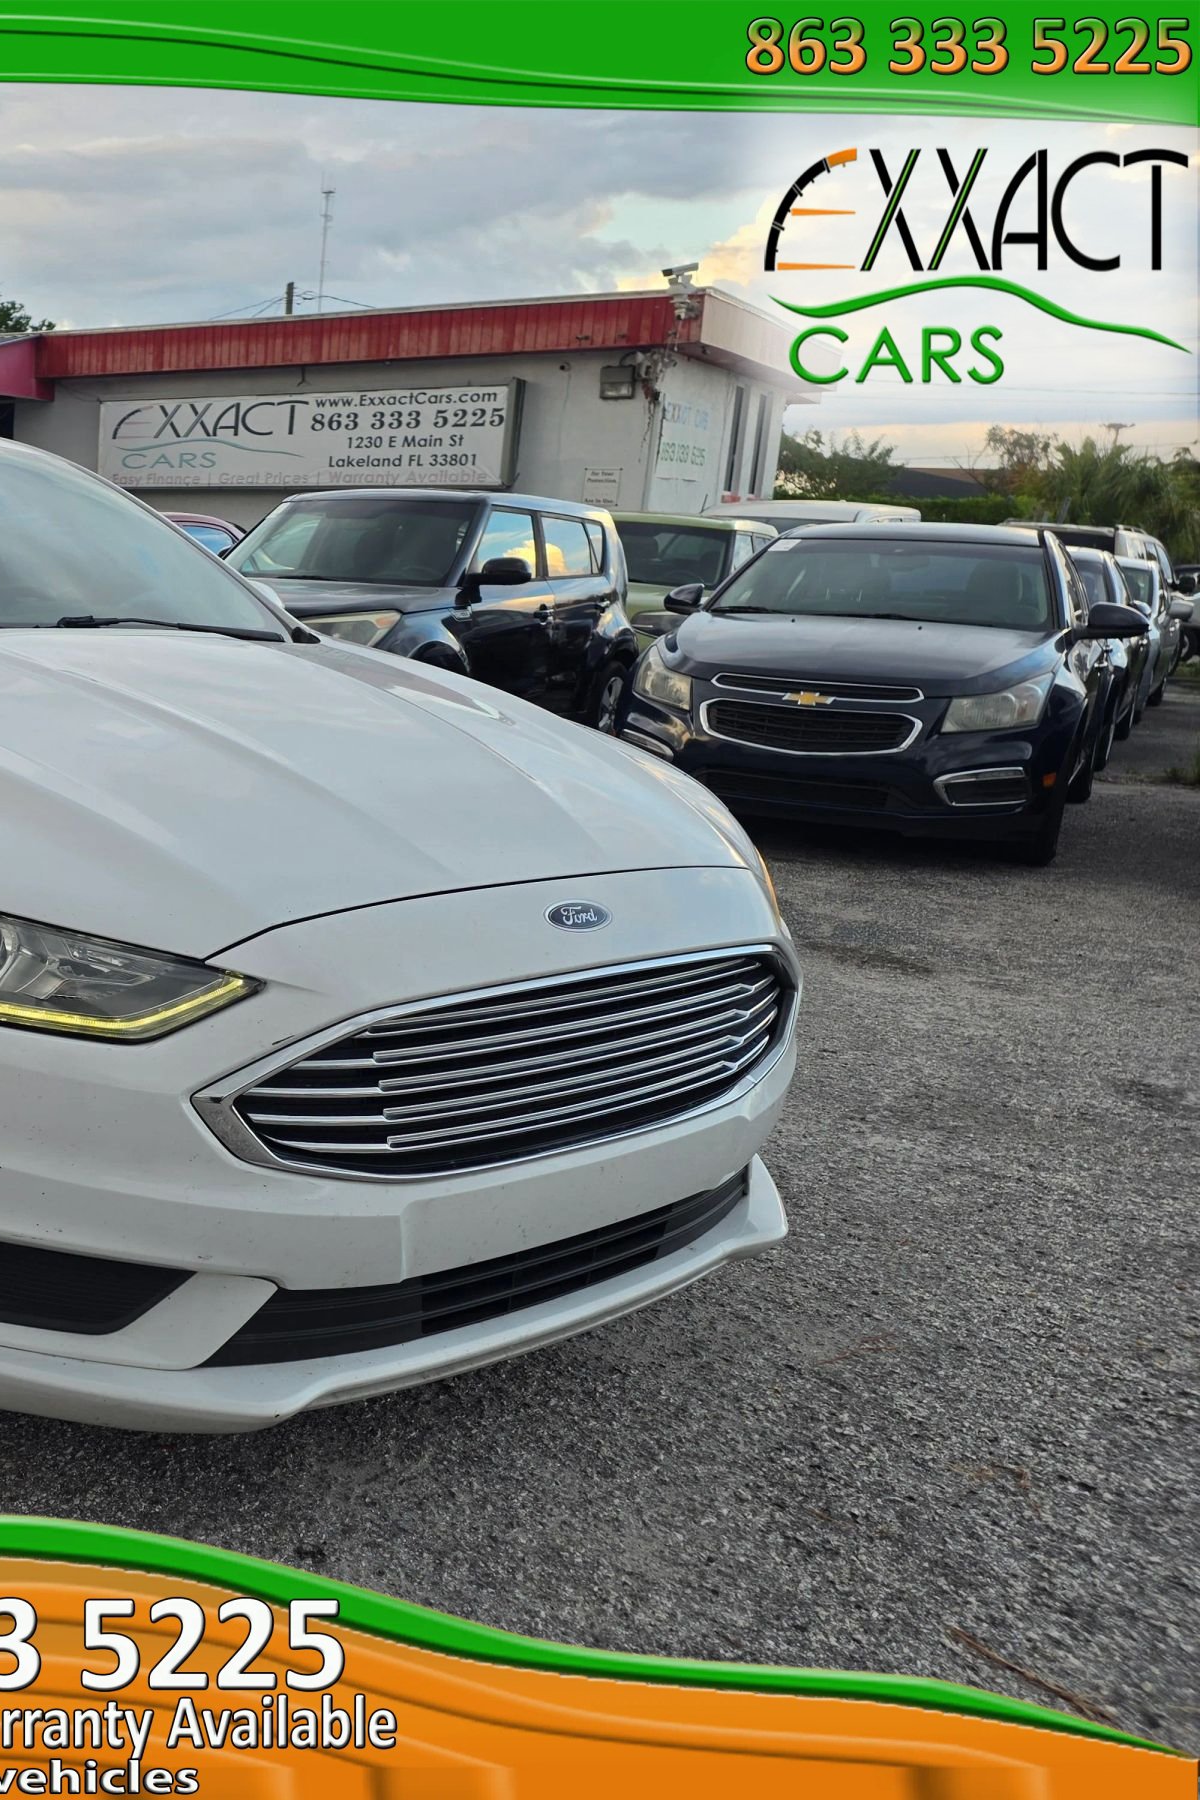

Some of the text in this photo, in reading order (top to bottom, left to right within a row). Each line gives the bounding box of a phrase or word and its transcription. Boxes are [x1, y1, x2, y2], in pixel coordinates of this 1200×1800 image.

[315, 391, 497, 408] www.ExxactCars.com
[111, 401, 310, 440] EXXACT
[310, 407, 505, 432] 863 333 5225
[347, 433, 464, 449] 1230 E Main St
[121, 451, 217, 470] CARS
[328, 453, 477, 468] Lakeland FL 33801
[146, 473, 201, 486] Finance
[218, 472, 263, 485] Great
[328, 471, 400, 486] Warranty
[405, 470, 487, 484] Available
[561, 906, 598, 925] Ford
